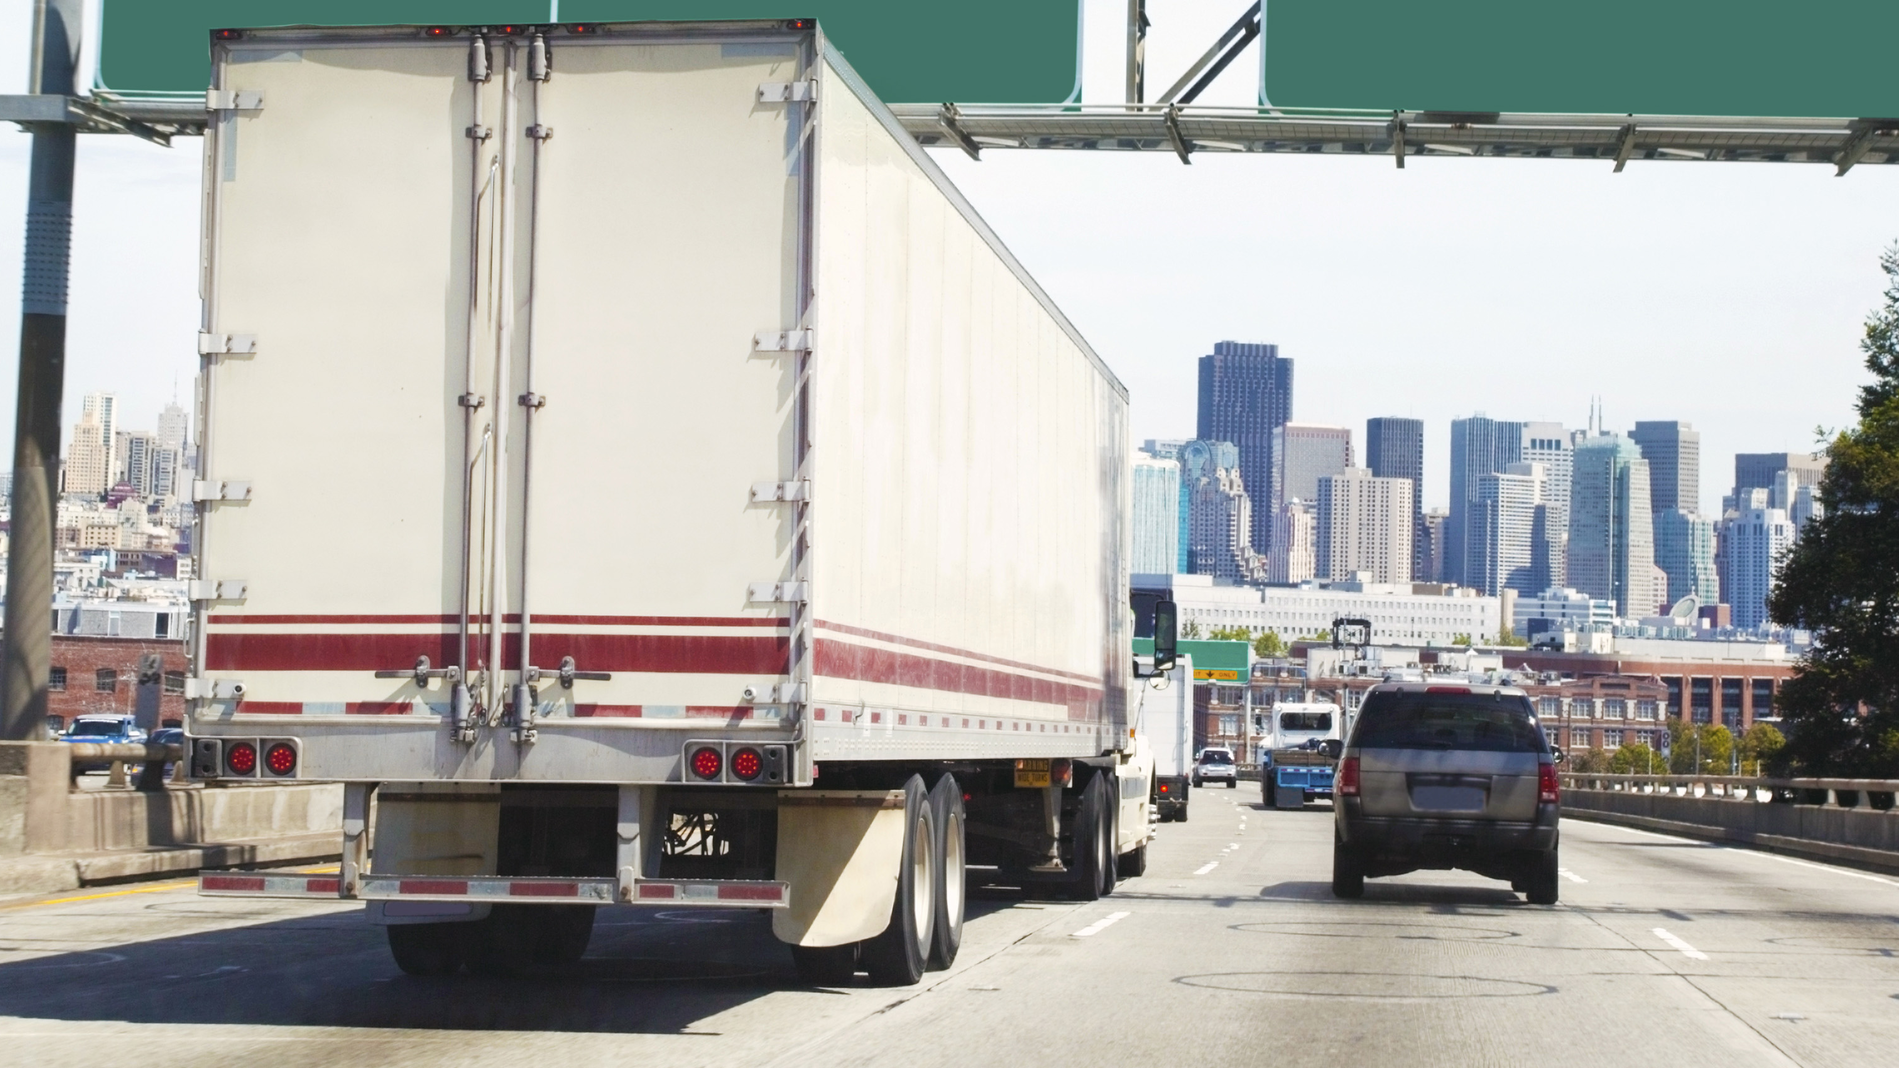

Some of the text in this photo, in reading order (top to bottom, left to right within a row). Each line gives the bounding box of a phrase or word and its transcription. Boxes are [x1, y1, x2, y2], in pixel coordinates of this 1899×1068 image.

[1020, 760, 1048, 770] ARNING
[1017, 772, 1048, 782] WIDE TURNS
